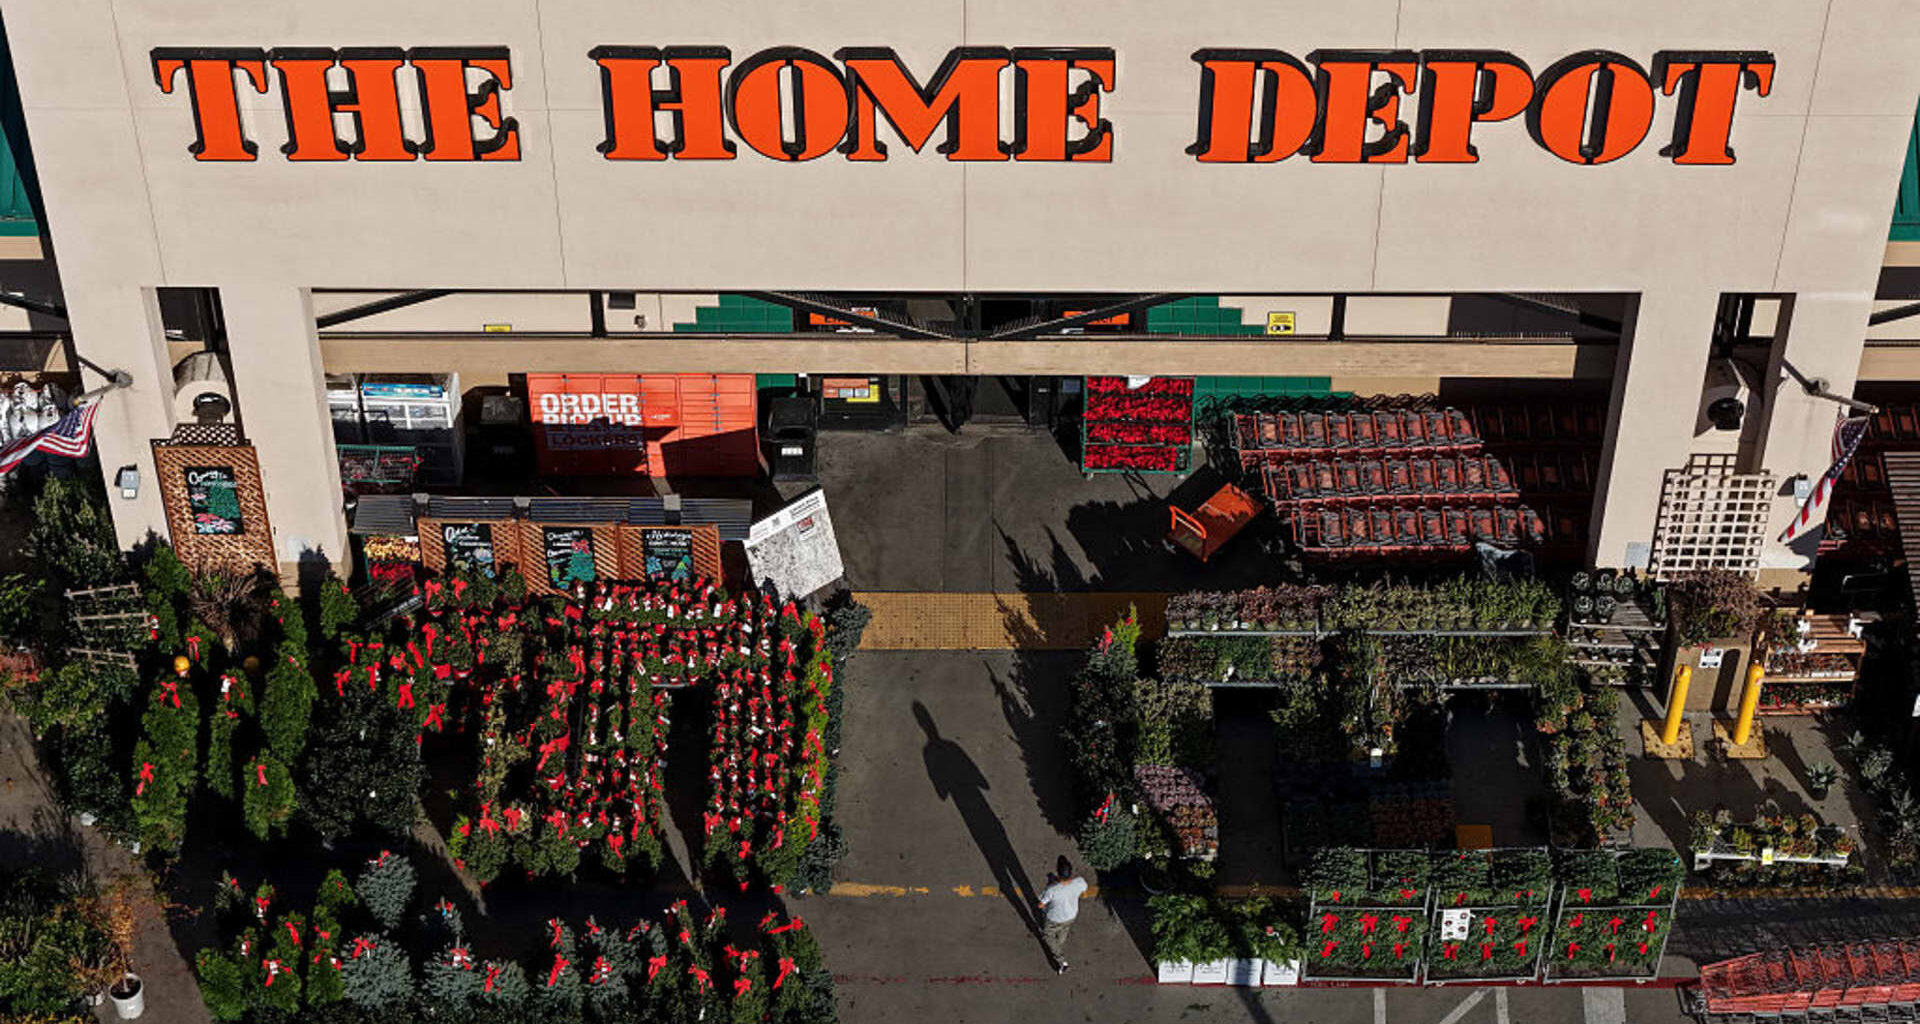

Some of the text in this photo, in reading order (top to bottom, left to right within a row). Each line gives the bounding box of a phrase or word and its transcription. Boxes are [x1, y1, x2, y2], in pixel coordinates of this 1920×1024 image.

[150, 45, 1776, 165] THE HOME DEPOT
[540, 393, 641, 414] ORDER
